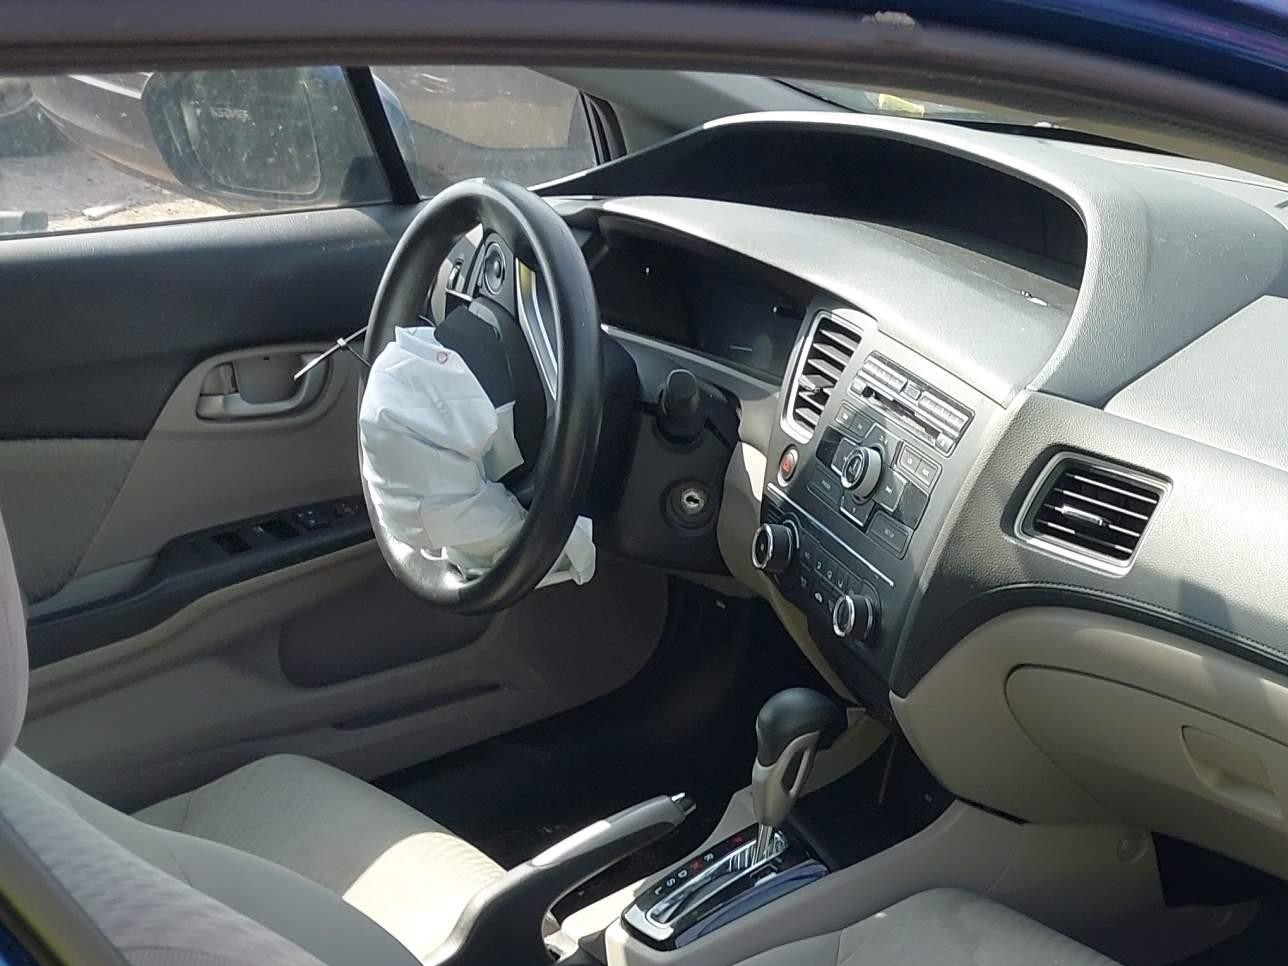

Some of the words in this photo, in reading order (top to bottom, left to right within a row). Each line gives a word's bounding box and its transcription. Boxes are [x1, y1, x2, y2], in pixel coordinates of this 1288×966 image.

[677, 869, 688, 878] D
[666, 878, 676, 887] S
[654, 886, 663, 896] L
